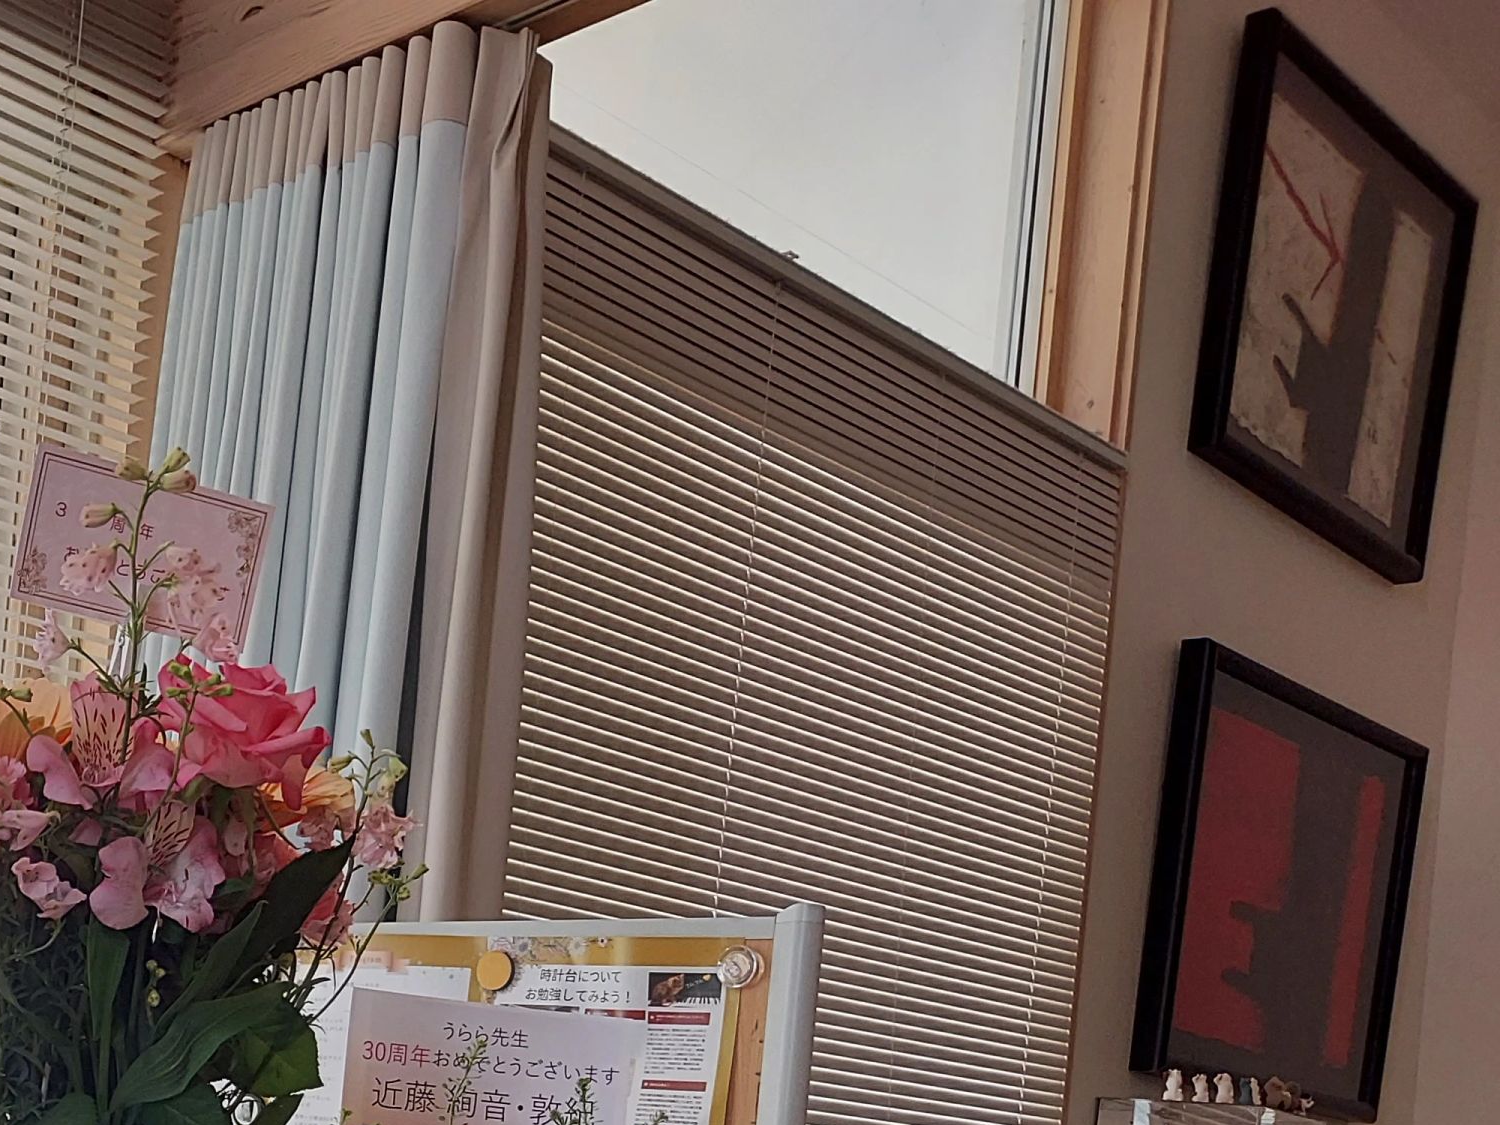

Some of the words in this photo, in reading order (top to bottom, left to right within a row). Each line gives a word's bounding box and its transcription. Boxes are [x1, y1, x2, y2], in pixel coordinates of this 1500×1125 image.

[539, 968, 622, 984] 時計台について
[443, 1022, 529, 1049] うらら先生
[372, 1076, 436, 1113] 近藤
